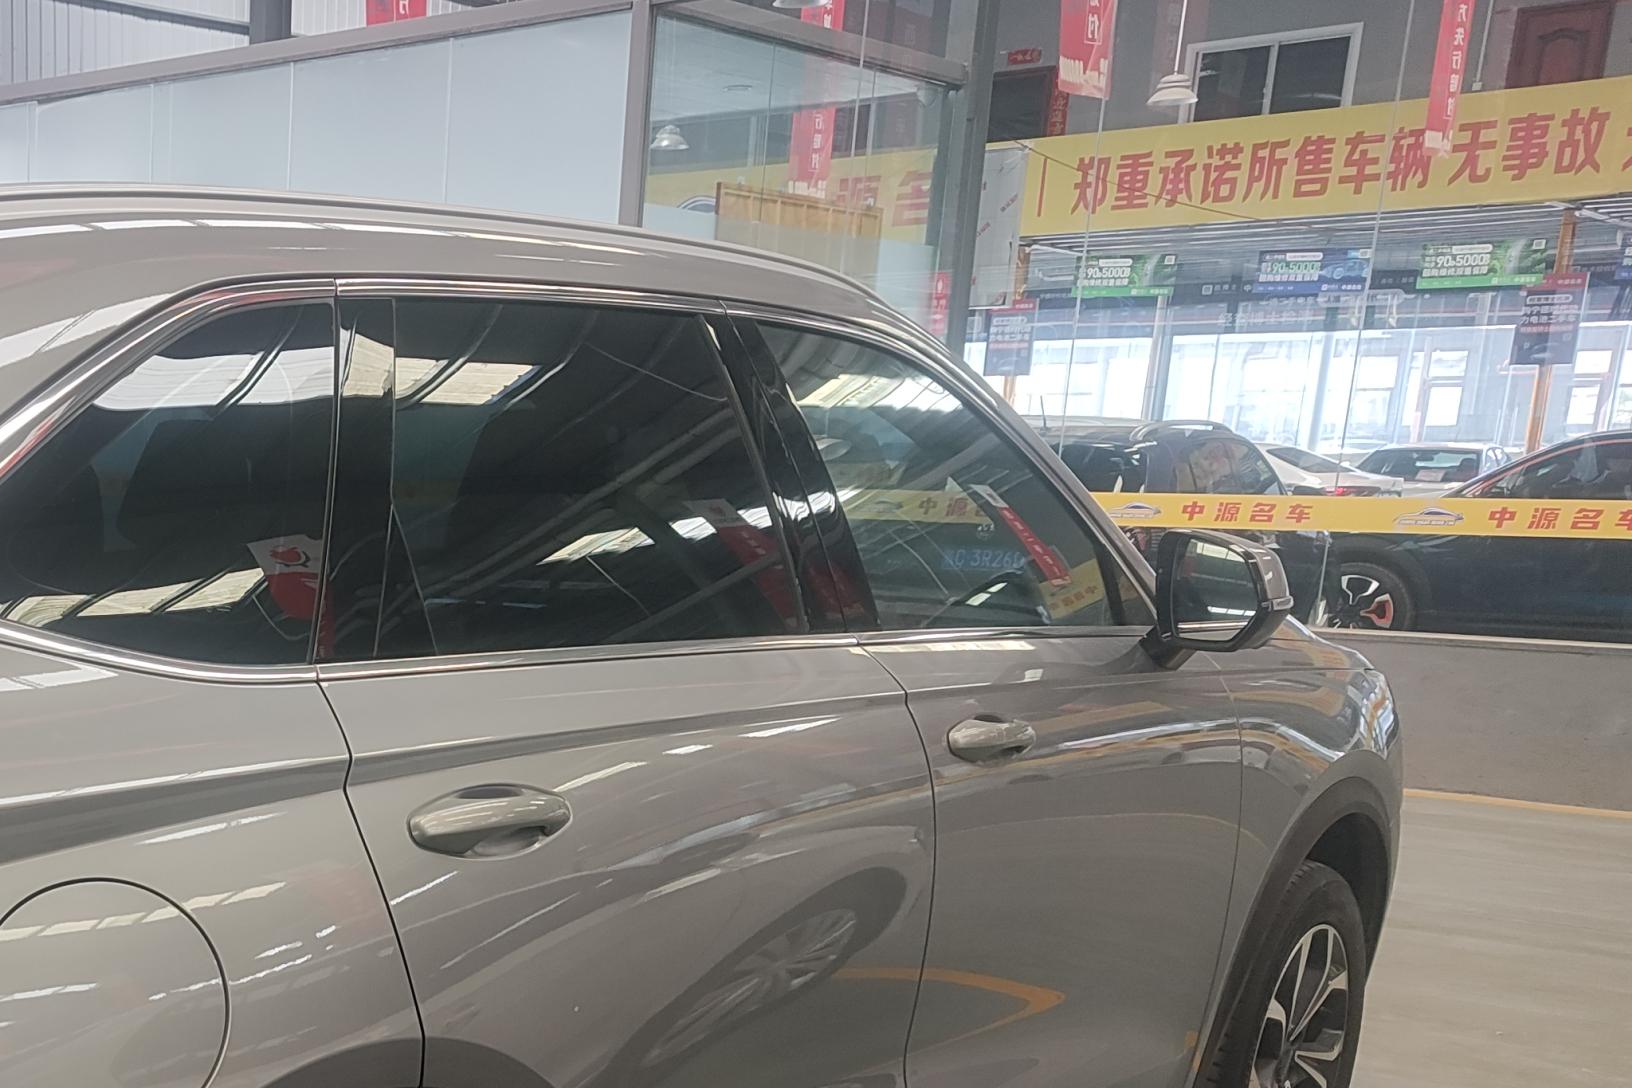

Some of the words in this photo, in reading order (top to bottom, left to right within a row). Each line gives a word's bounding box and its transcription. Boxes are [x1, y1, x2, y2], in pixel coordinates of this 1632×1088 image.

[1070, 106, 1632, 216] 郑重承诺所售车辆无事故
[1182, 501, 1314, 524] 中源名车
